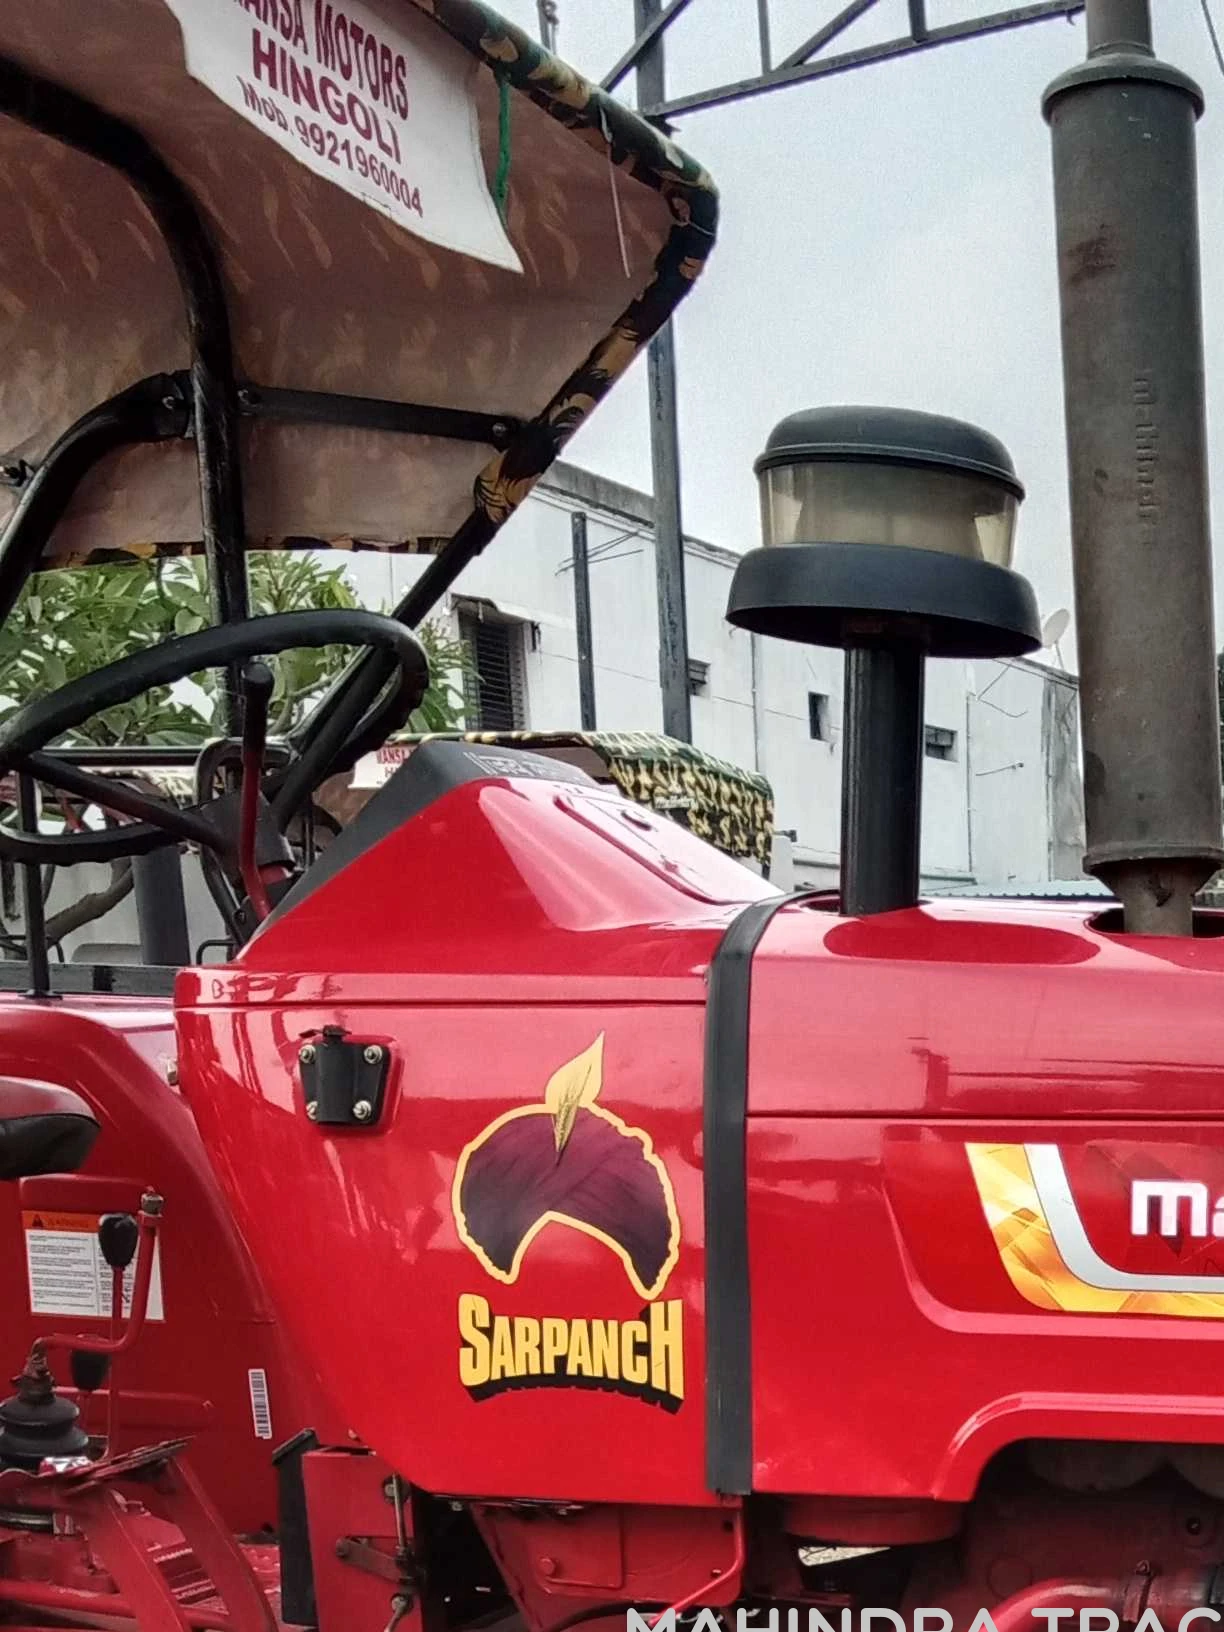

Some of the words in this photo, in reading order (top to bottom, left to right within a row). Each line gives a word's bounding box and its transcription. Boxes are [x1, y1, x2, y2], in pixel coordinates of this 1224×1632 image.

[252, 28, 401, 164] HINGOLI
[314, 0, 409, 120] MOTORS
[458, 1292, 685, 1410] SARPANCH
